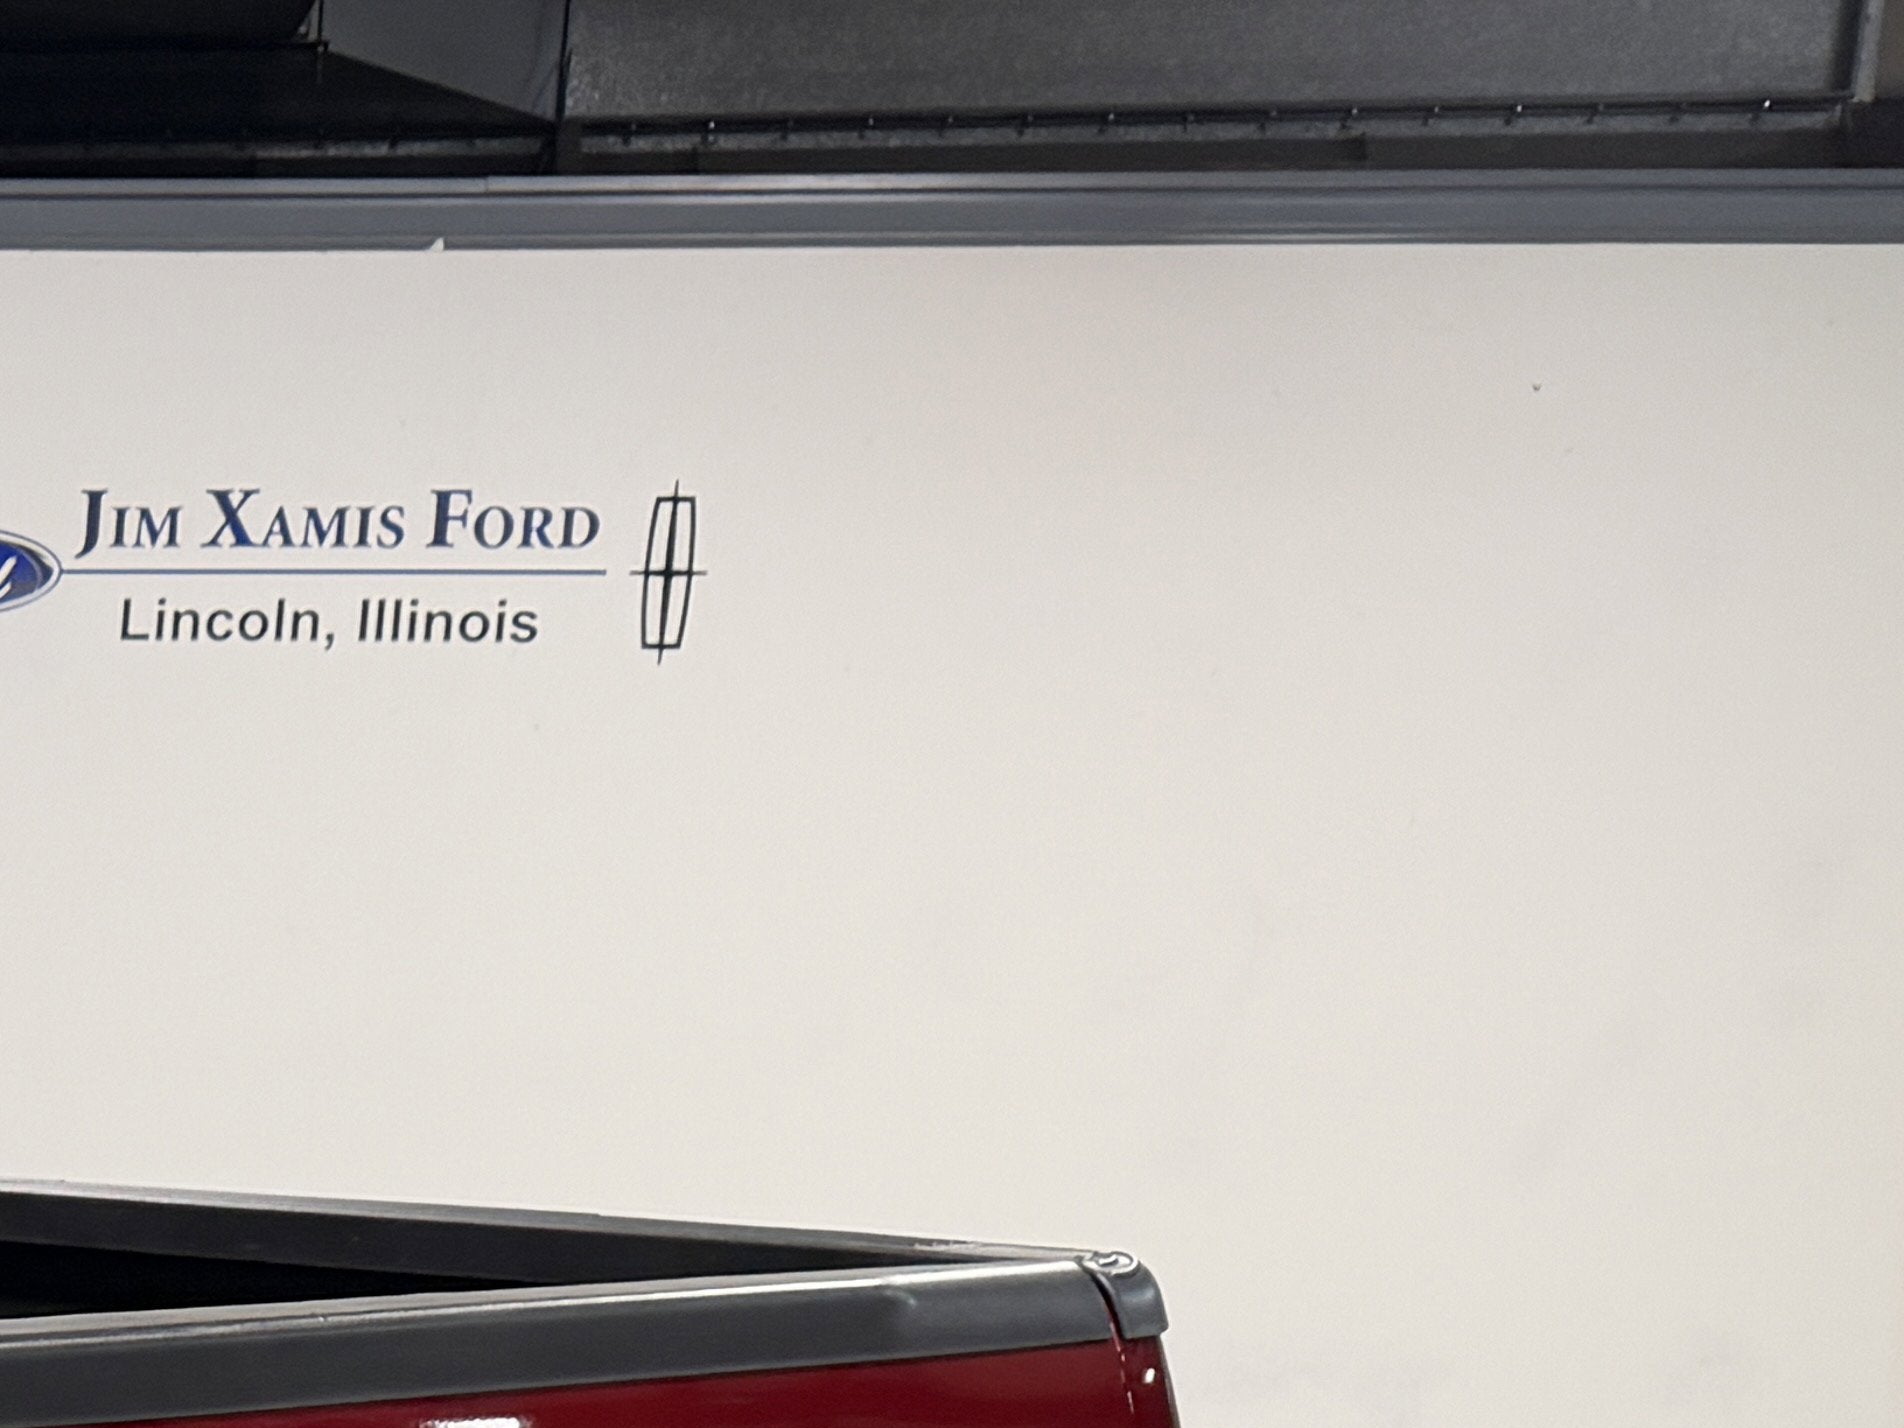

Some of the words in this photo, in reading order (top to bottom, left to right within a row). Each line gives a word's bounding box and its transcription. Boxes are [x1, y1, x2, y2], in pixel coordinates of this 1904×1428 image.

[73, 488, 181, 559] JIM
[206, 488, 406, 550] XAMIS
[425, 488, 602, 552] FORD
[119, 596, 336, 649] Lincoln,
[356, 596, 540, 645] Illinois
